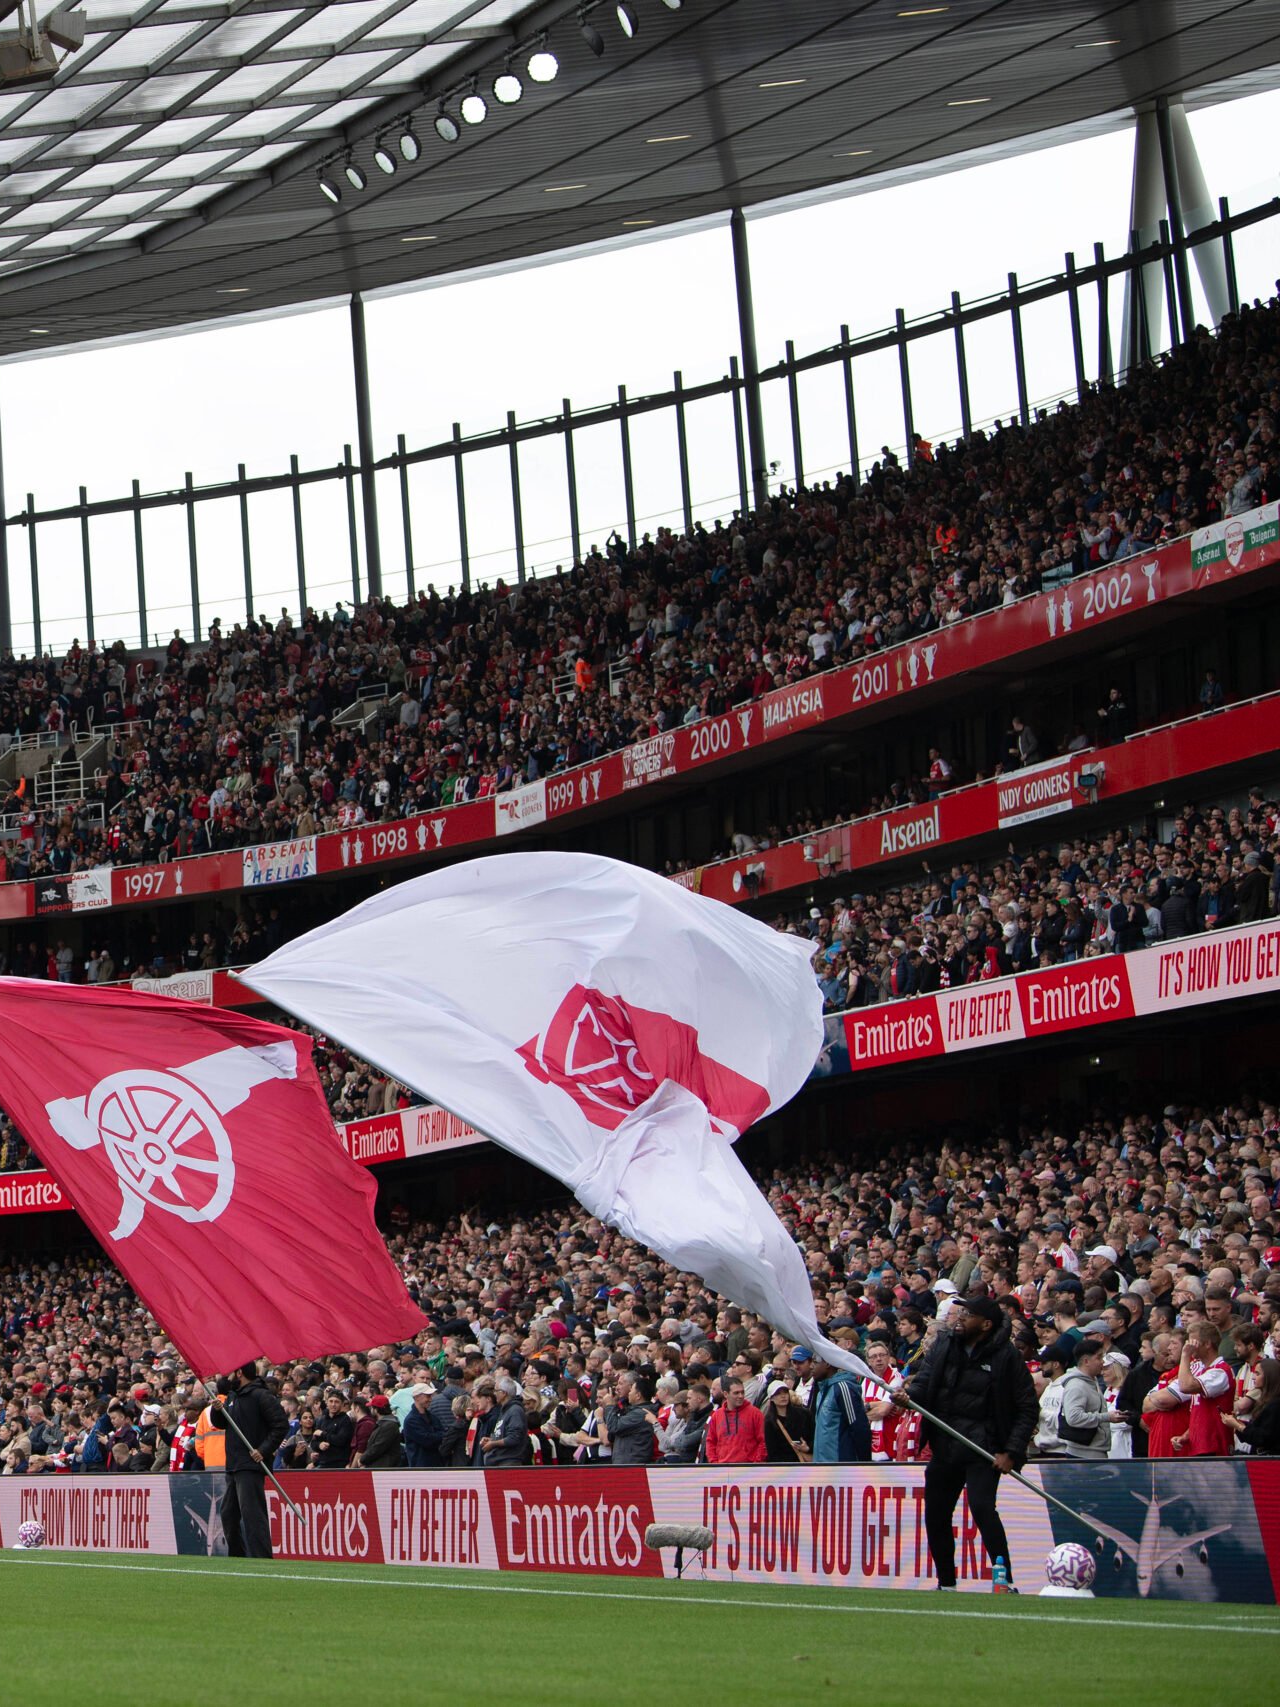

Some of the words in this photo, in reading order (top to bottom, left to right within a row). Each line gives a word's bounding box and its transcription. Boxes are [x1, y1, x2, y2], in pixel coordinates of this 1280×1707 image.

[1083, 571, 1132, 620] 2002
[851, 662, 889, 703] 2001
[763, 687, 823, 729] MALAYSIA
[690, 718, 731, 761] 2000
[548, 780, 574, 812] 1999
[999, 786, 1021, 812] INDY
[1023, 771, 1070, 805] GOONERS
[245, 838, 314, 862] ARSENAL
[372, 827, 408, 857] 1998
[880, 805, 940, 855] Arsenal
[124, 871, 165, 898] 1997
[252, 861, 310, 884] HELLAS
[37, 901, 86, 913] SUPPORTERS
[88, 898, 109, 907] CLUB
[1158, 950, 1184, 999] IT'S
[1187, 943, 1222, 993] HOW
[1226, 937, 1252, 985] YOU
[948, 998, 967, 1042] FLY
[969, 989, 1011, 1038] BETTER
[1028, 972, 1121, 1026] Emirates
[853, 1013, 933, 1061] Emirates
[351, 1124, 399, 1160] Emirates
[417, 1112, 430, 1146] IT'S
[431, 1110, 449, 1143] HOW
[20, 1488, 39, 1524] IT'S
[42, 1488, 65, 1546] HOW
[68, 1488, 89, 1547] YOU
[93, 1488, 113, 1548] GET
[115, 1488, 150, 1549] THERE
[268, 1486, 369, 1559] Emirates
[390, 1488, 418, 1561] FLY
[420, 1488, 480, 1565] BETTER
[504, 1485, 643, 1568] Emirates
[702, 1484, 741, 1572] IT'S
[749, 1485, 802, 1574] HOW
[811, 1486, 853, 1576] YOU
[862, 1485, 906, 1577] GET
